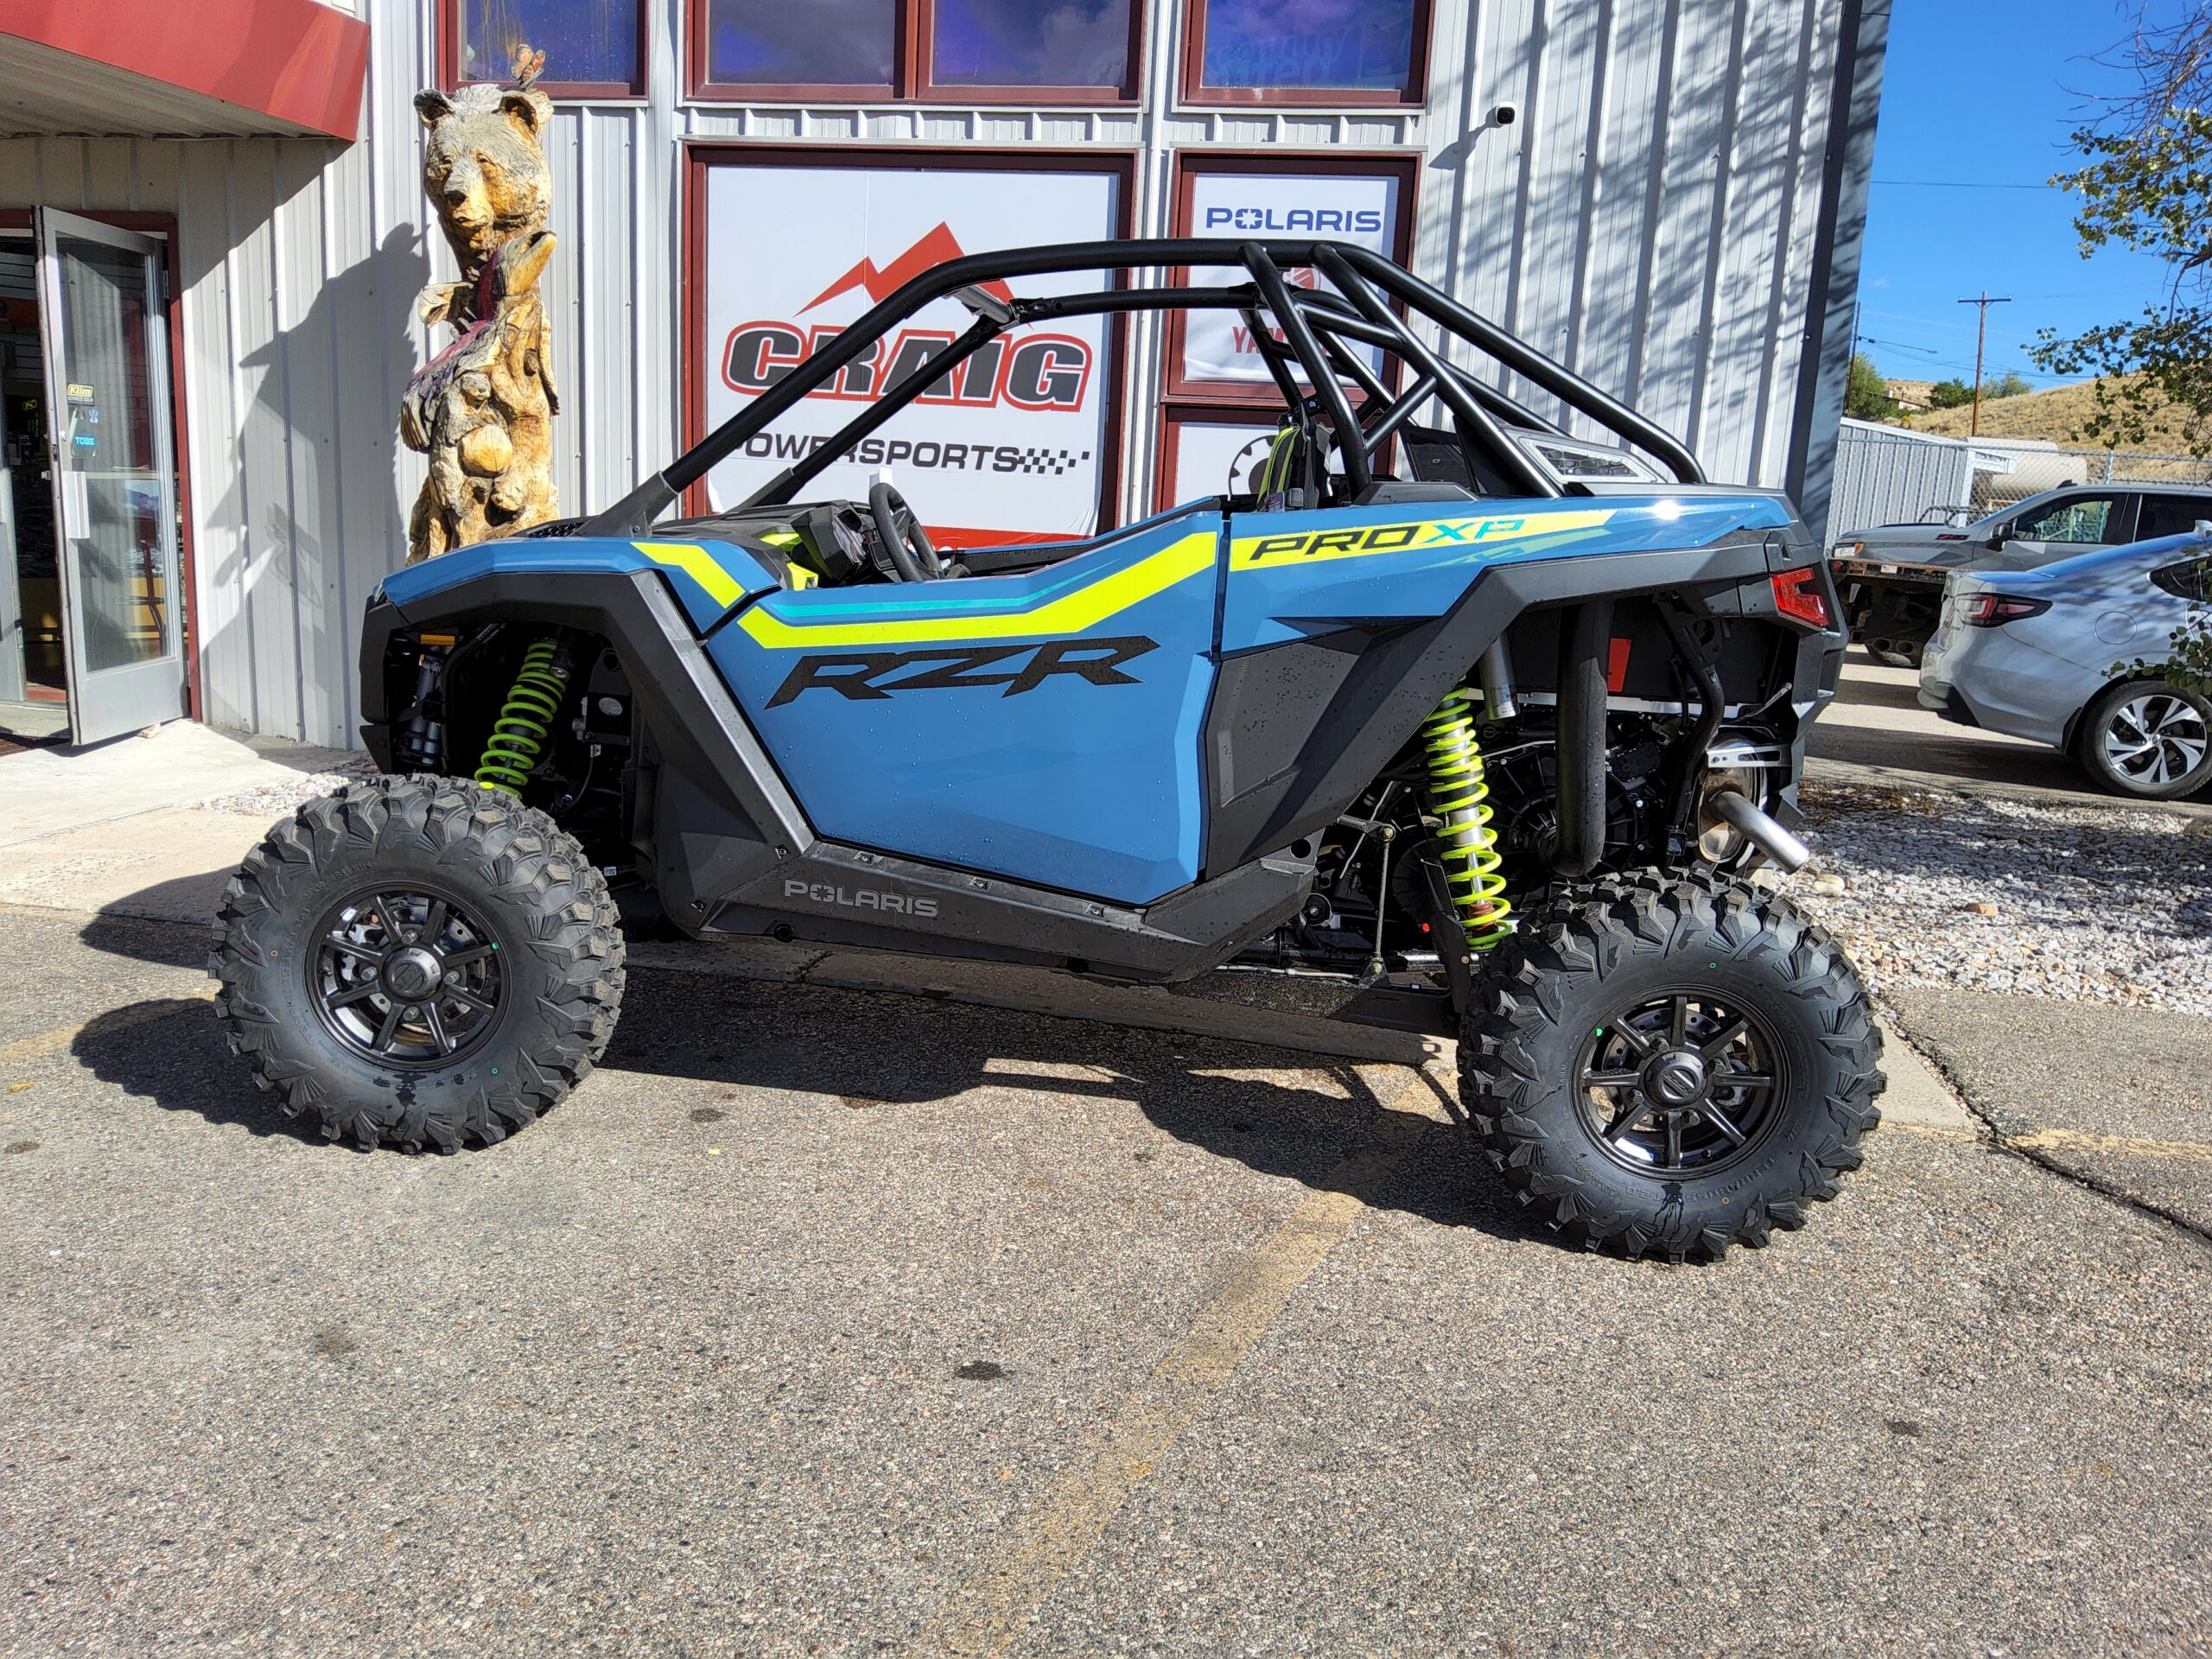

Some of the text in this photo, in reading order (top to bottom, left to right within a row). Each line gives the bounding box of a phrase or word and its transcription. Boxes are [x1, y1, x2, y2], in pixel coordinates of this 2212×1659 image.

[1206, 207, 1382, 232] POLARIS
[734, 430, 1020, 473] OWSPORTS
[1249, 519, 1526, 561] PRO XP
[764, 635, 1161, 710] RZR
[784, 879, 939, 918] POLARIS
